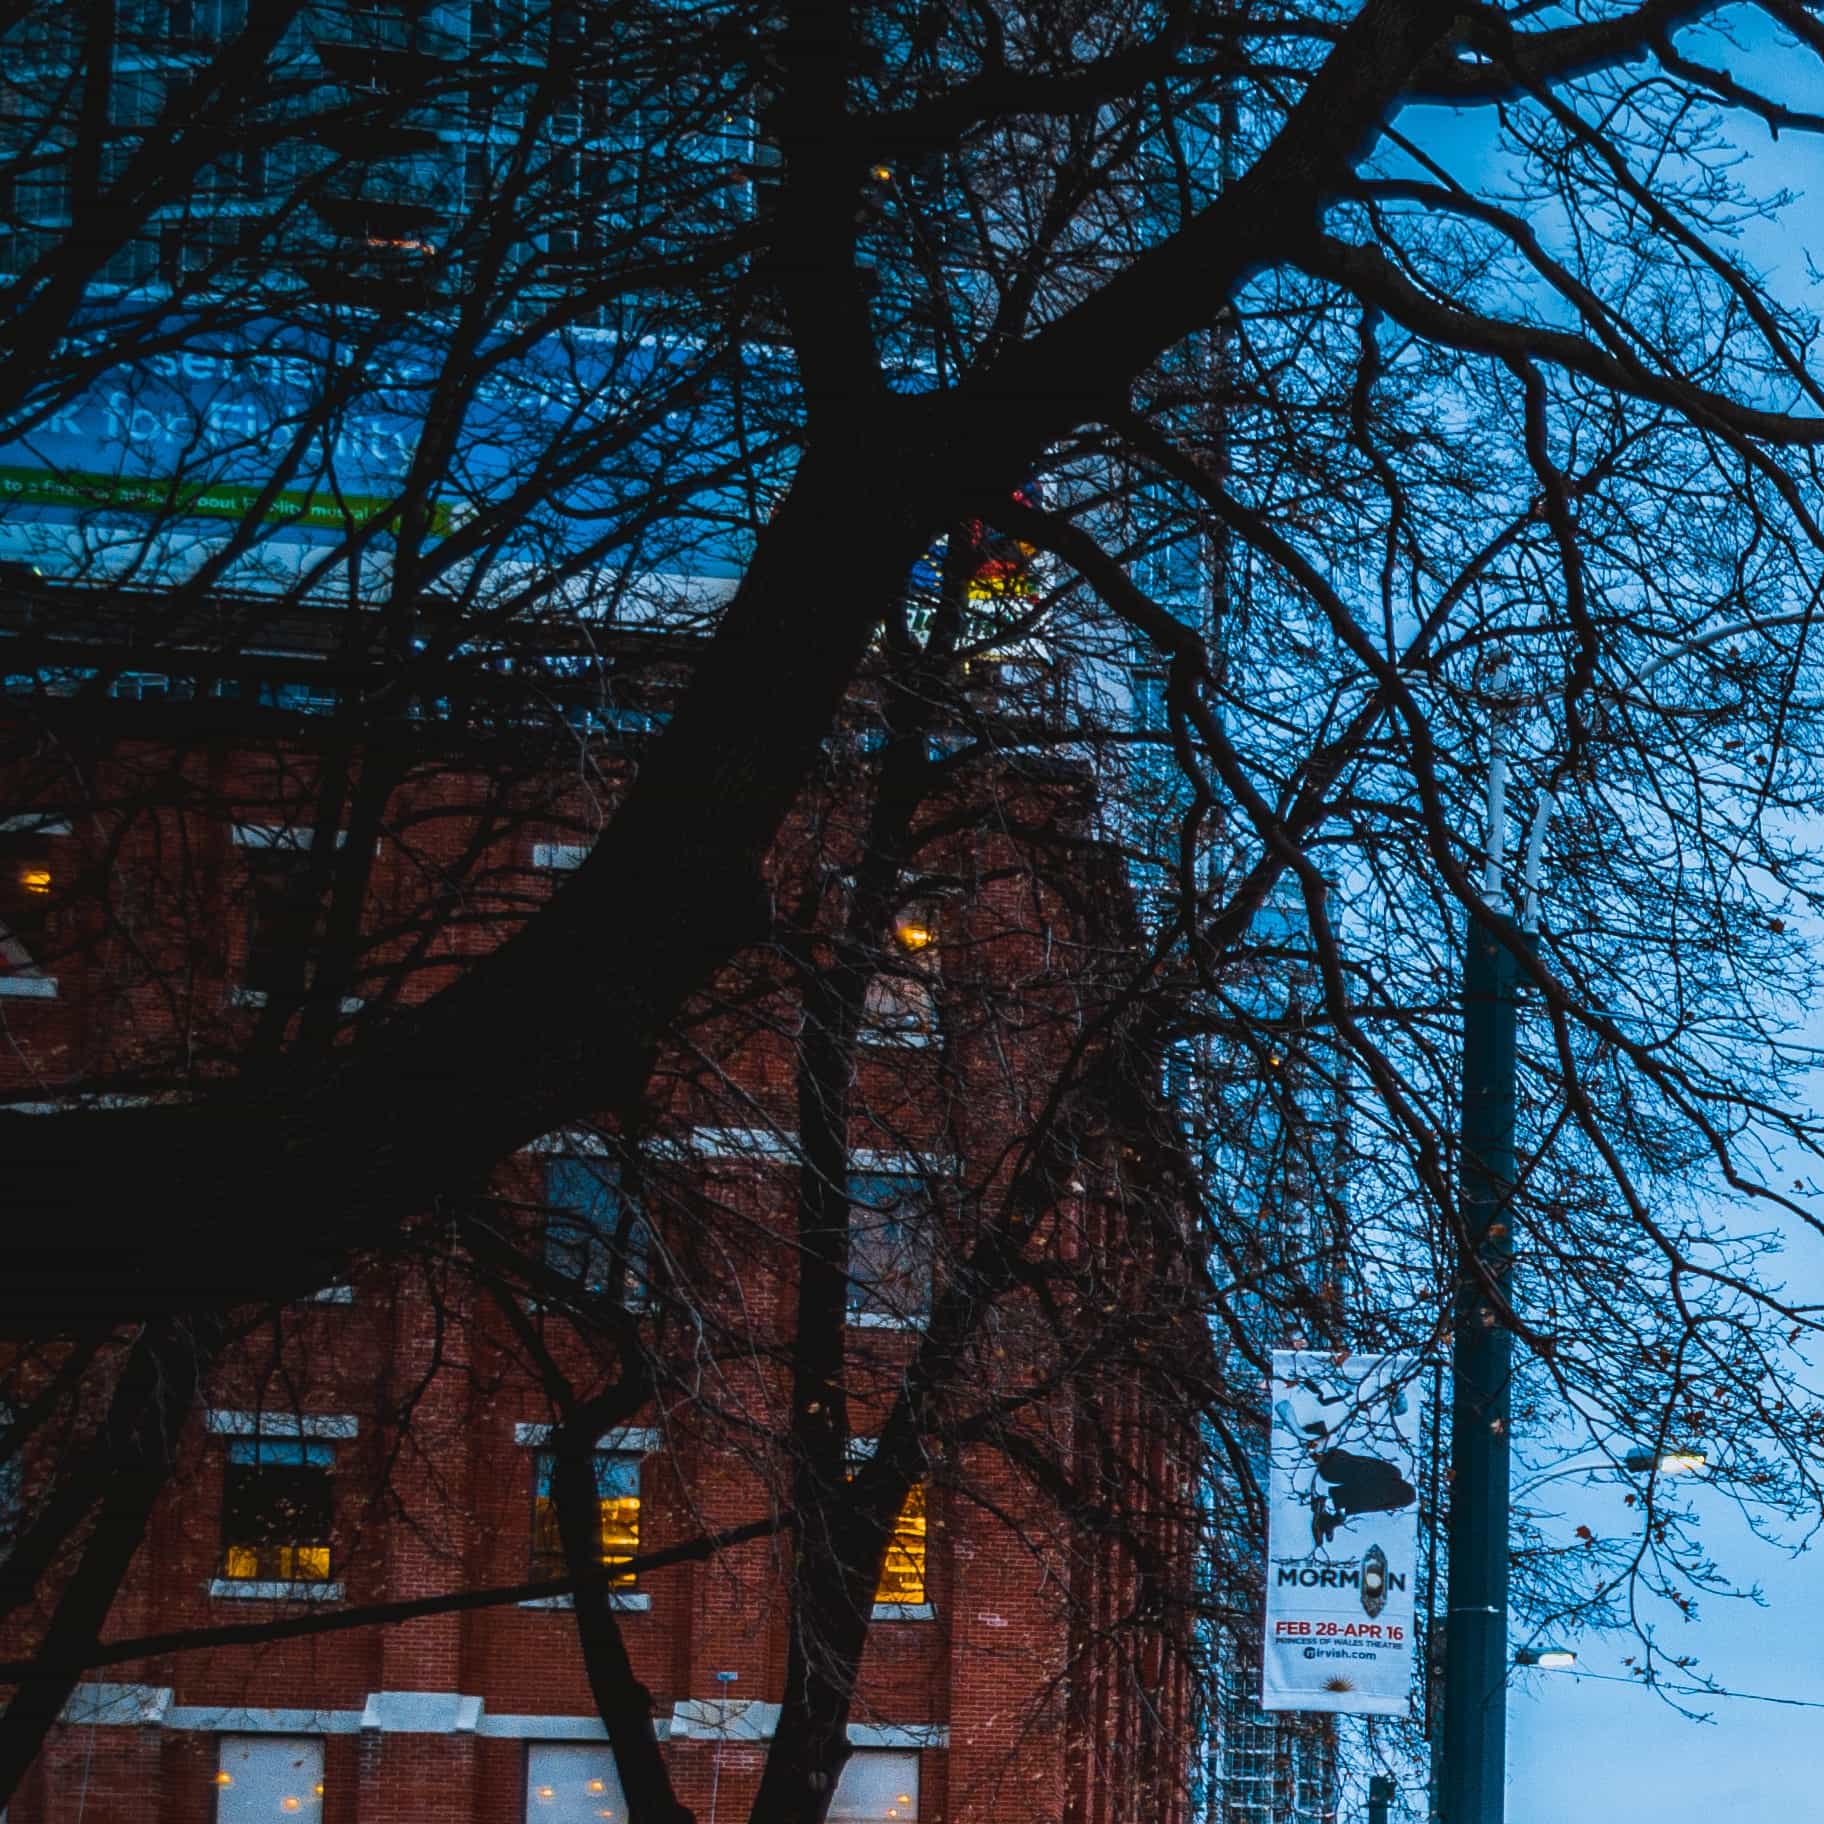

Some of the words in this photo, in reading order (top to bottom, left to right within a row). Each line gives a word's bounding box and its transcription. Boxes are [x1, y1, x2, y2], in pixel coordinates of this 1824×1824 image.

[1276, 1621, 1311, 1636] FEB
[1315, 1622, 1382, 1639] 28-APR
[1386, 1626, 1404, 1640] 16
[1319, 1638, 1331, 1646] OF
[1334, 1639, 1364, 1648] WALES
